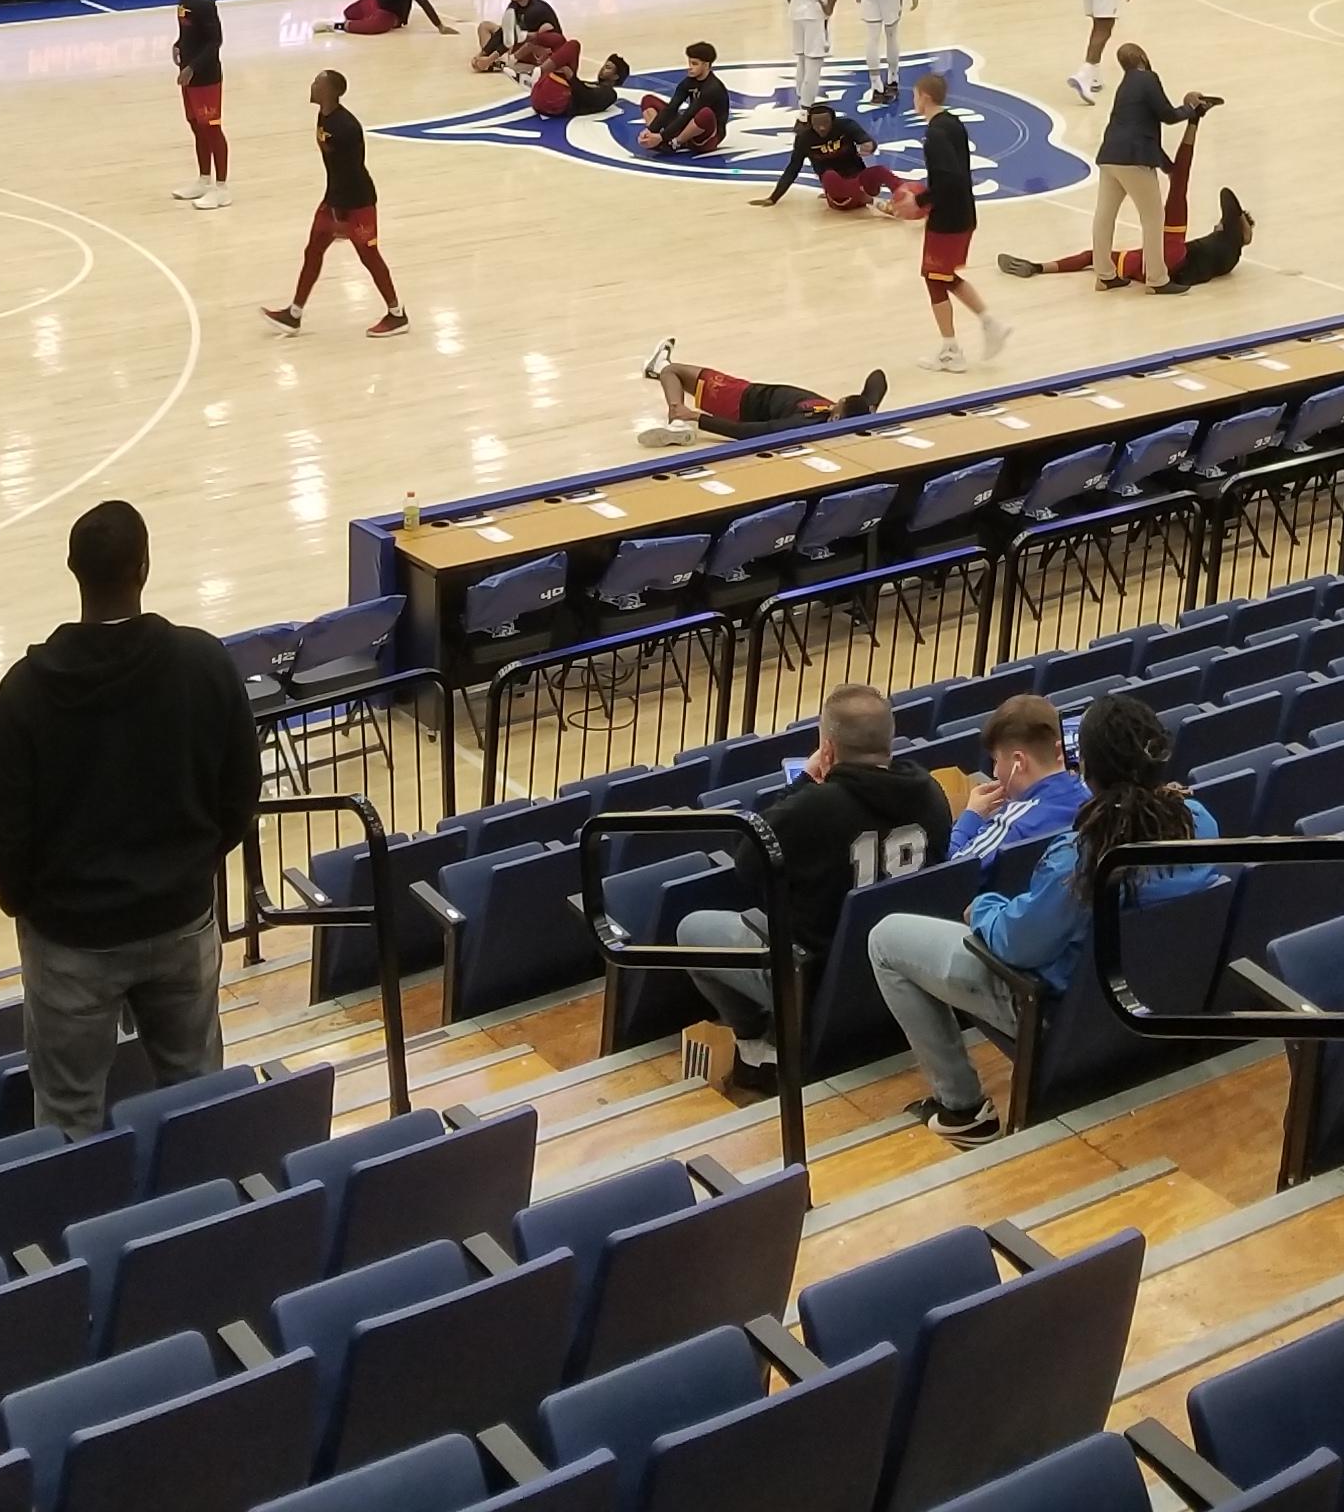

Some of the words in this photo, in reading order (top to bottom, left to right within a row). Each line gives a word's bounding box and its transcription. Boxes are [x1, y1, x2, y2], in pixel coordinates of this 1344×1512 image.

[860, 517, 882, 531] 37
[671, 572, 694, 586] 39
[539, 586, 566, 601] 40
[270, 650, 297, 666] 42
